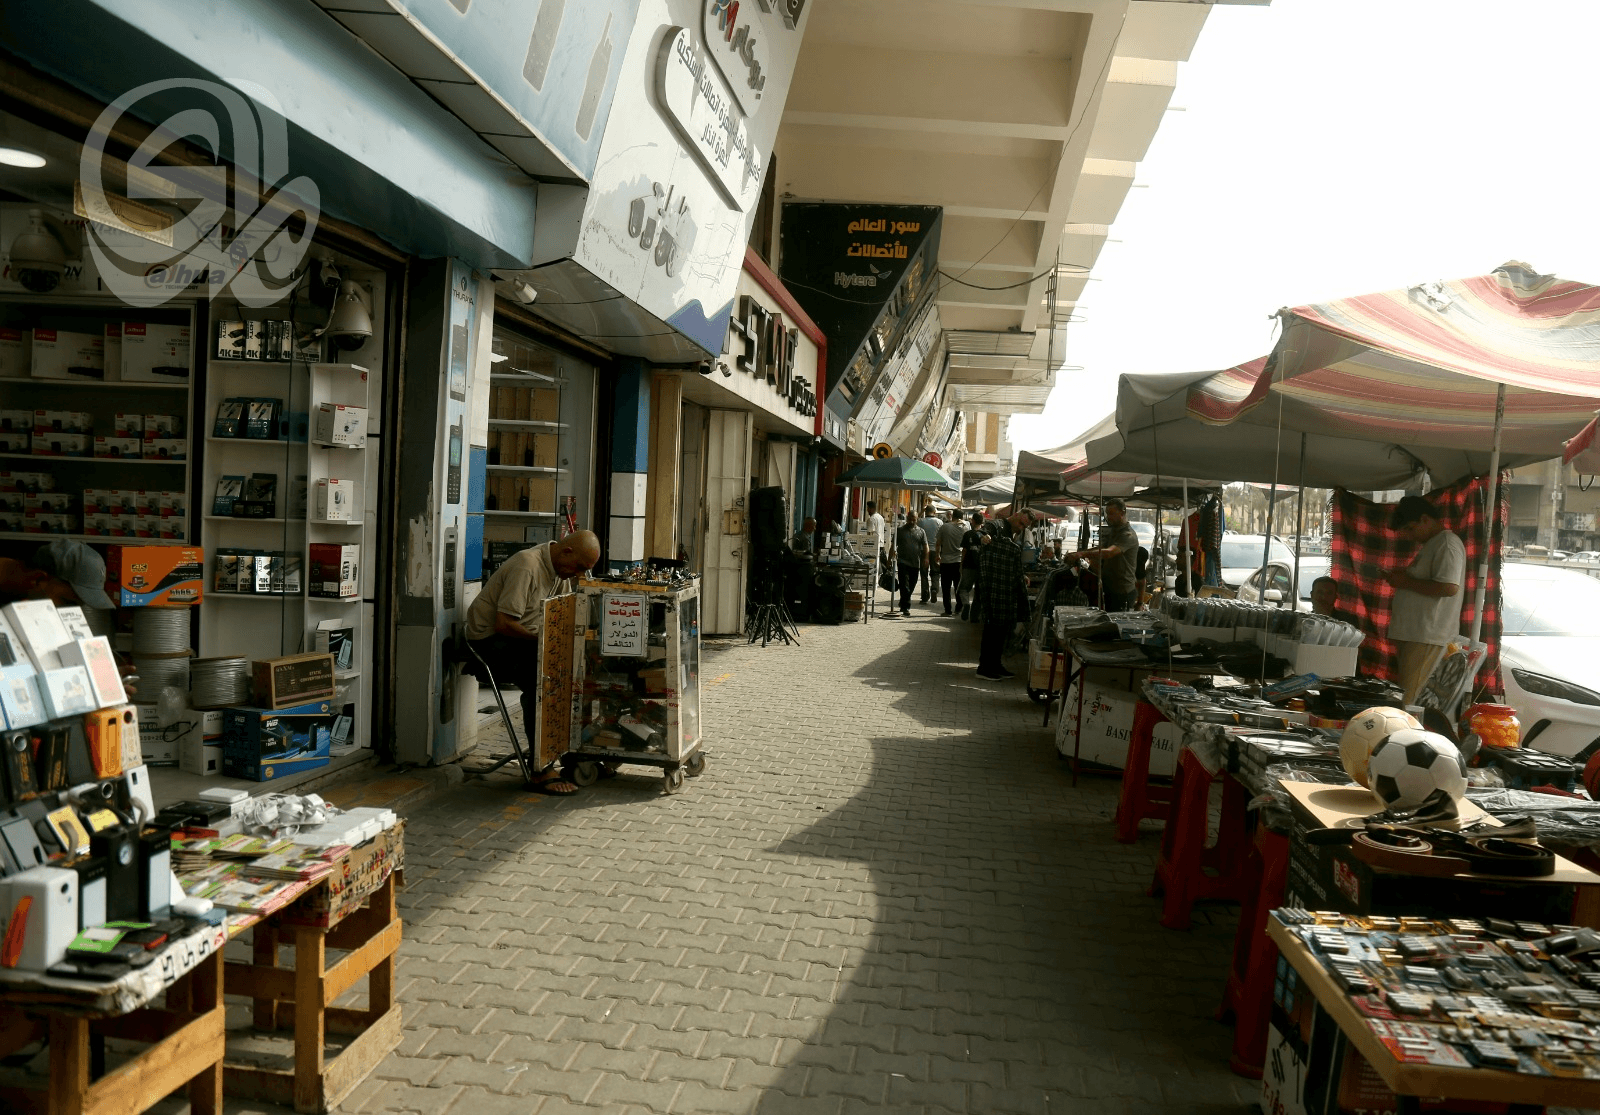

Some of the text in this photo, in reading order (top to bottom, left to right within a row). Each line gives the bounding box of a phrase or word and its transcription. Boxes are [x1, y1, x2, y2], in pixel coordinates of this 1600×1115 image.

[847, 218, 921, 235] سور العالم
[834, 271, 877, 289] Hytera
[452, 288, 475, 306] THURAYA
[219, 349, 231, 357] 4K
[611, 620, 636, 628] شراء
[607, 630, 638, 639] الدولار
